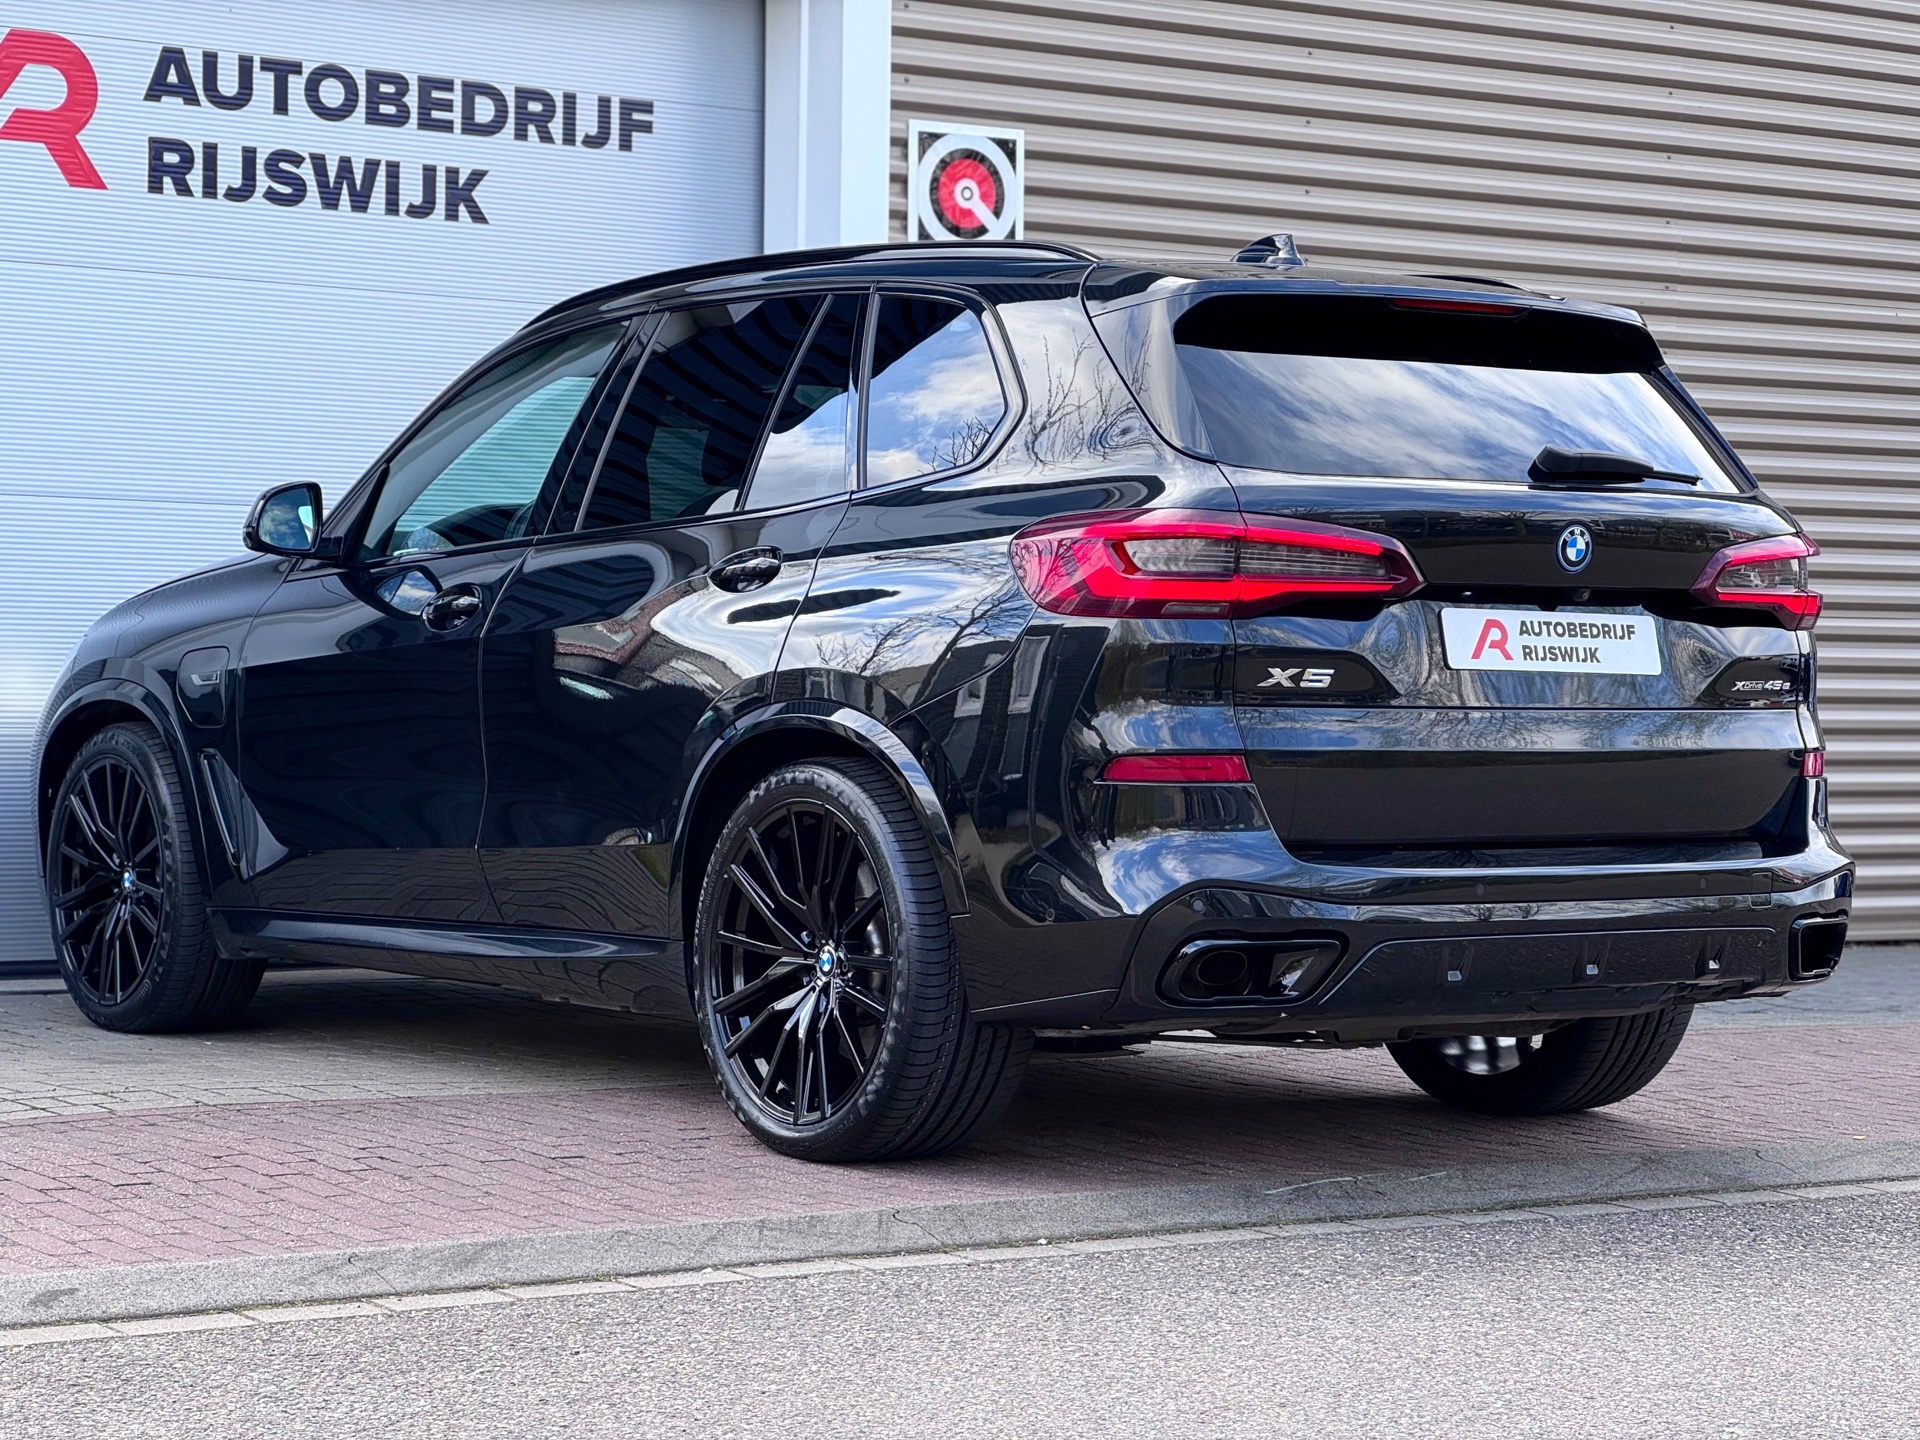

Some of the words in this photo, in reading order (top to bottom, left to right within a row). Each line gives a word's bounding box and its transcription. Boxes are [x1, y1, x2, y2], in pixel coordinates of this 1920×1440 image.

[143, 46, 653, 152] AUTOBEDRIJF
[147, 136, 490, 224] RIJSWIJK
[1519, 620, 1636, 641] AUTOBEDRIJF
[1522, 645, 1601, 664] RIJSWIJK
[1257, 667, 1336, 688] X5
